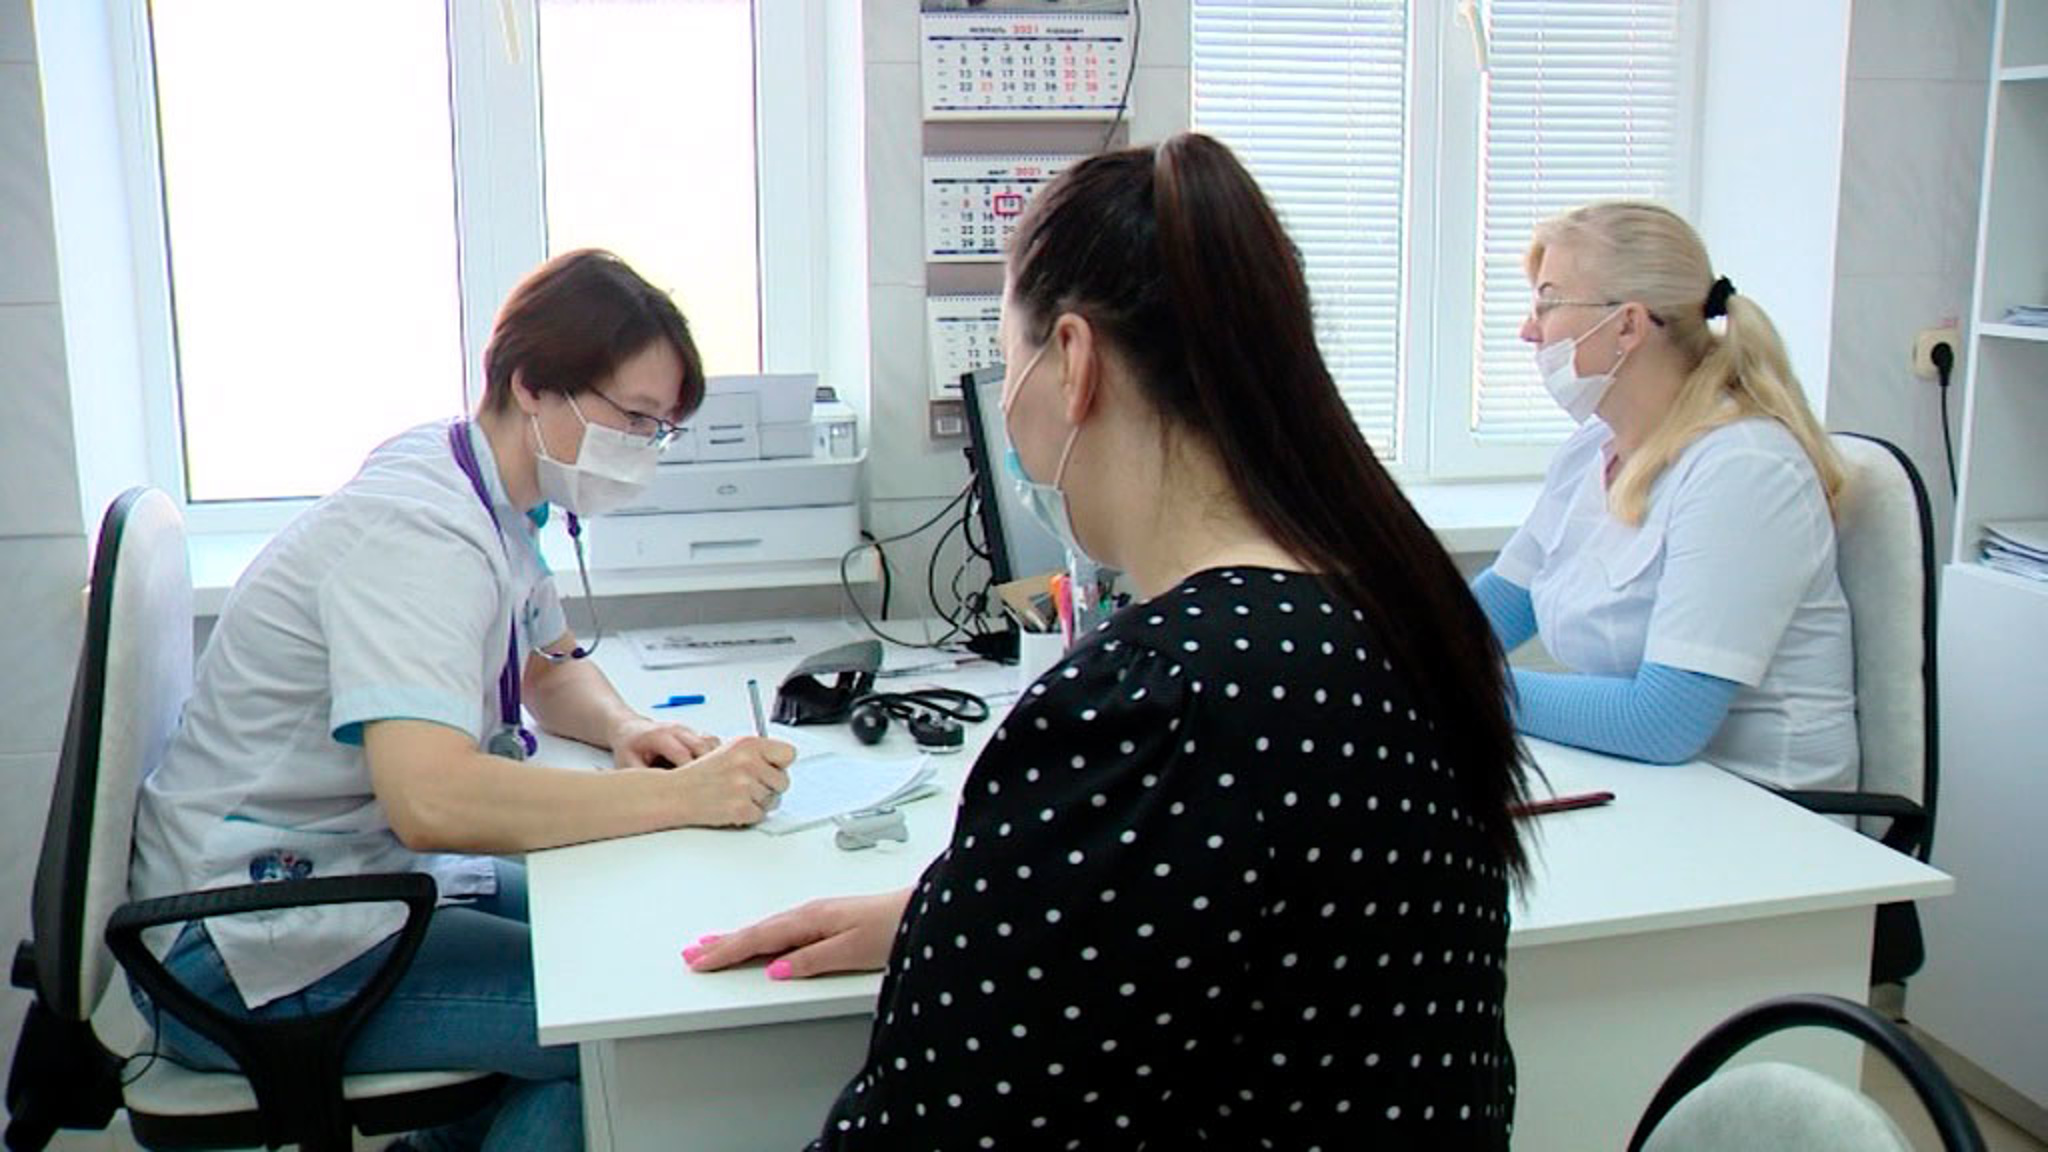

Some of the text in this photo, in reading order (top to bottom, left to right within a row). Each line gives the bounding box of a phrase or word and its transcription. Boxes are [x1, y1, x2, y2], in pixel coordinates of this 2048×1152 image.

[1022, 56, 1033, 65] 11
[1042, 56, 1056, 65] 12
[1002, 69, 1014, 78] 17
